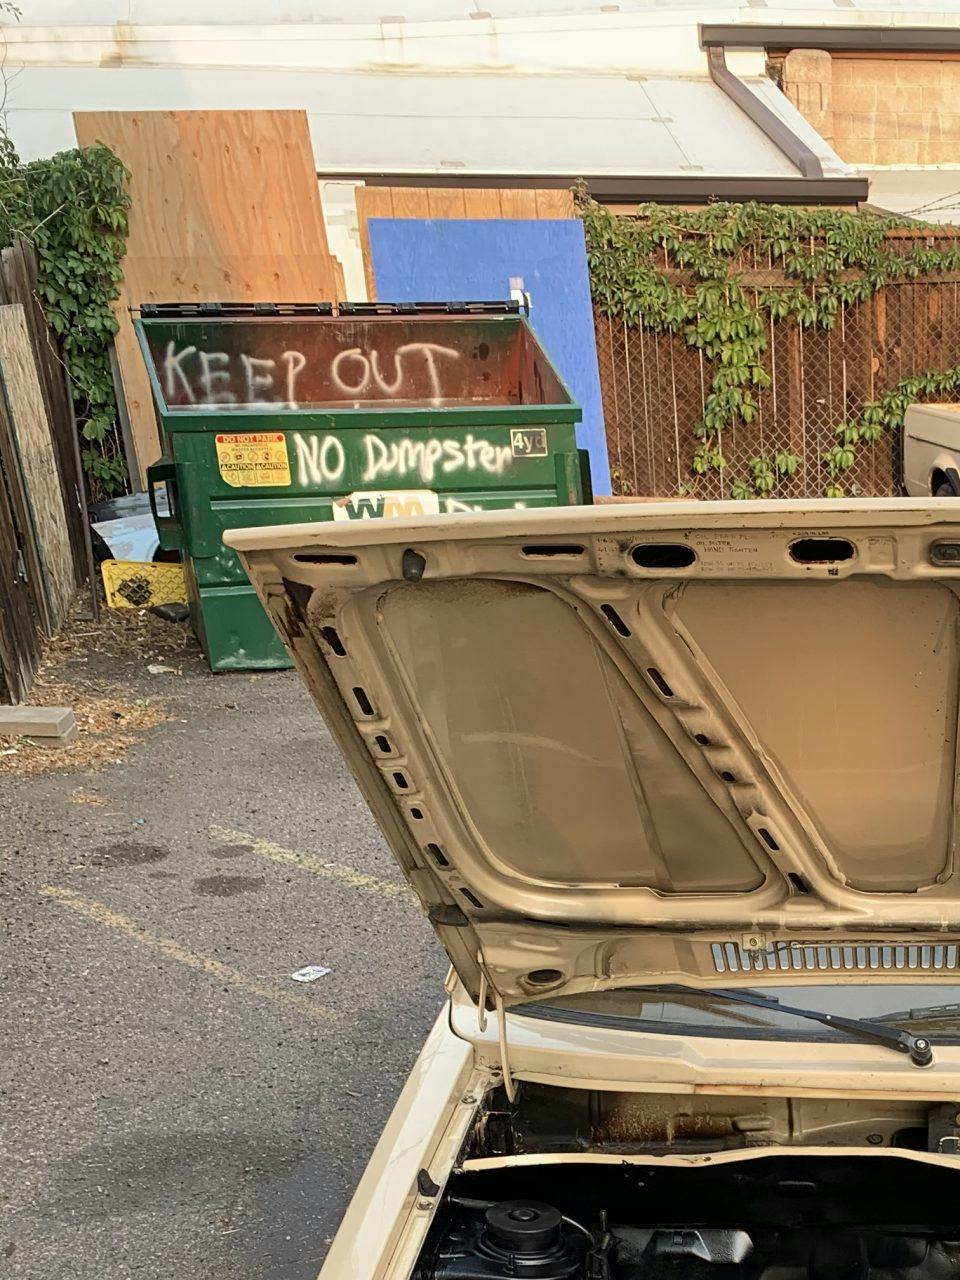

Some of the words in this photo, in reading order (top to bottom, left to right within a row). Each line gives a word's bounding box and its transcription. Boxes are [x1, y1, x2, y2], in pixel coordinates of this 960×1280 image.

[164, 339, 307, 410] KEEP
[331, 342, 461, 407] OUT
[223, 435, 236, 443] DO
[237, 435, 254, 443] NOT
[256, 434, 278, 443] PARK
[513, 431, 546, 453] 4yd
[262, 462, 288, 471] CAUTION
[293, 432, 346, 486] NO
[227, 463, 255, 471] CAUTION
